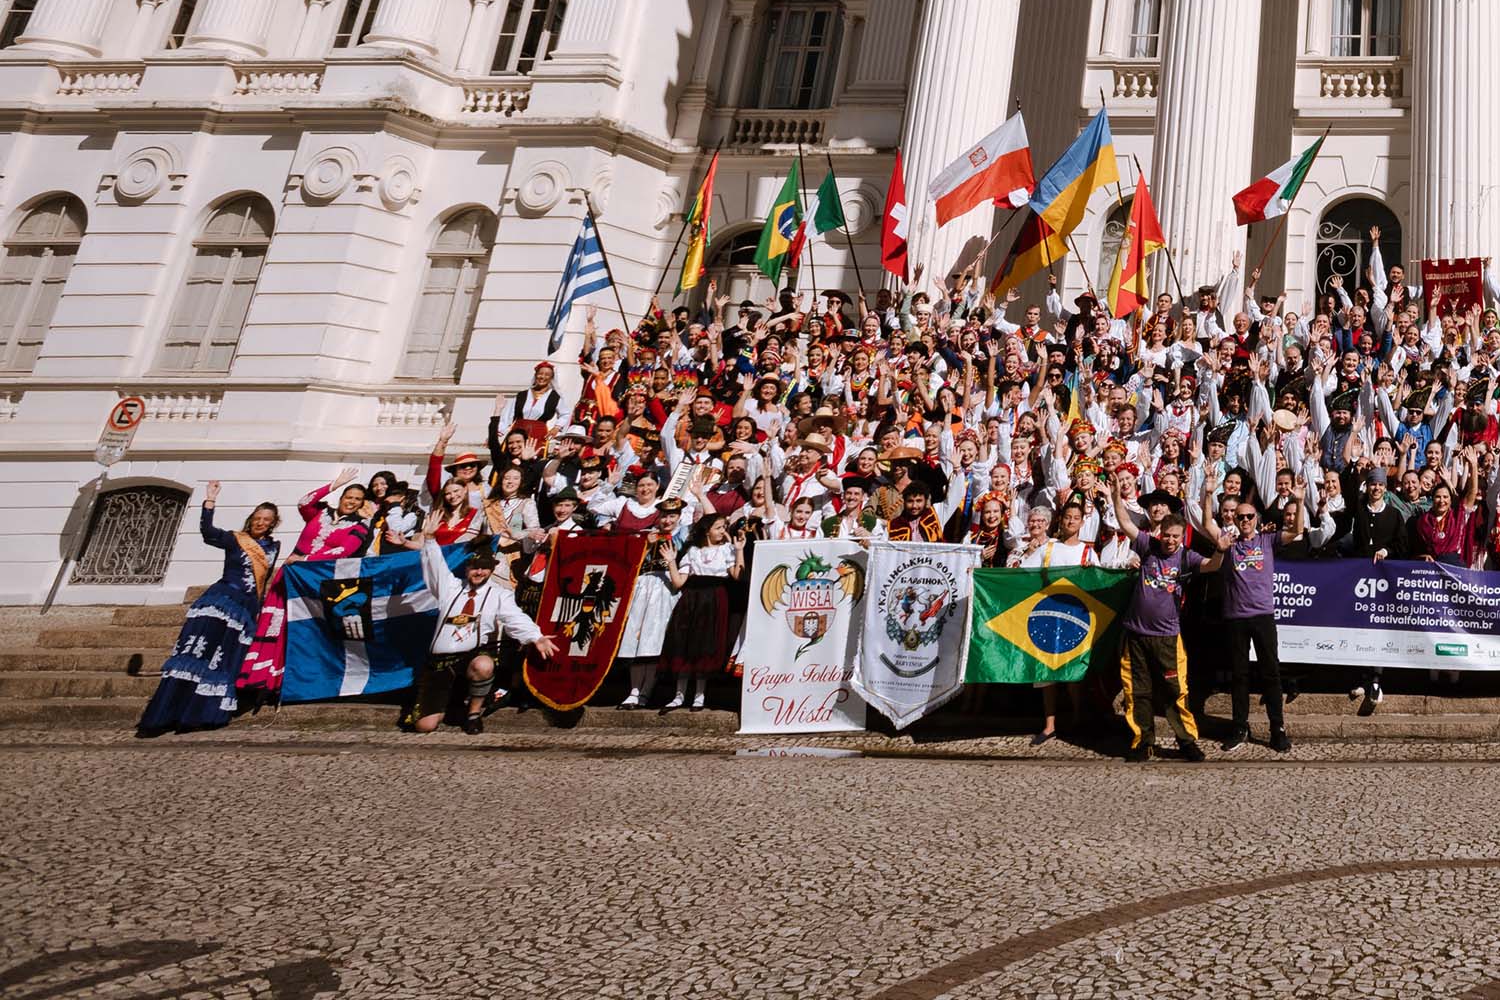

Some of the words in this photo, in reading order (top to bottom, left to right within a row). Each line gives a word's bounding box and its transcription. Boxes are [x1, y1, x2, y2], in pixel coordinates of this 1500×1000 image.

[1273, 573, 1290, 582] em
[1397, 577, 1443, 589] Festival
[1273, 582, 1317, 595] OlclOre
[792, 591, 832, 607] WISŁA
[1282, 595, 1313, 607] todo
[1396, 590, 1410, 601] de
[1413, 591, 1450, 602] Etnias
[1451, 593, 1466, 604] do
[1274, 608, 1296, 620] gar
[1355, 602, 1368, 612] De
[1369, 603, 1376, 612] 3
[1386, 603, 1395, 613] 13
[1397, 604, 1409, 613] de
[1410, 604, 1435, 616] julho
[1442, 606, 1474, 617] Teatro
[1369, 613, 1494, 630] festivalfolclorico.com.br
[747, 666, 795, 693] Grupo
